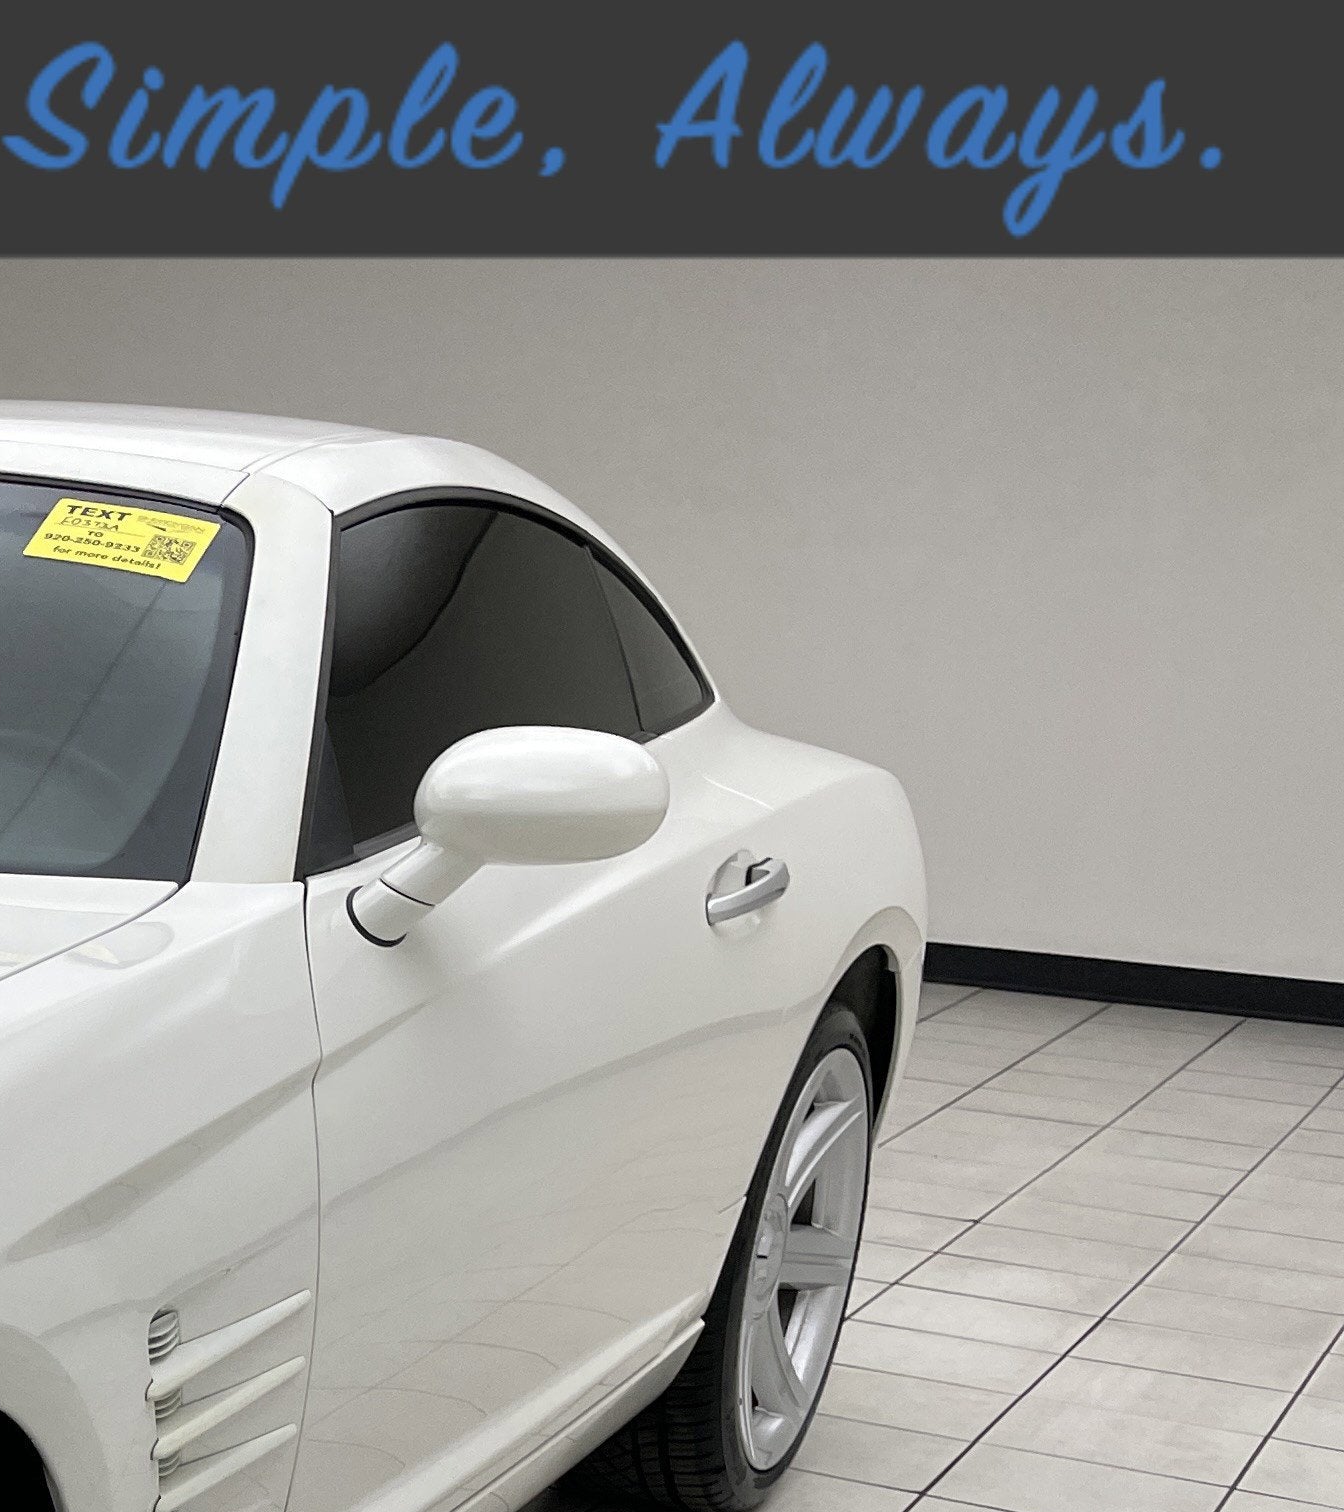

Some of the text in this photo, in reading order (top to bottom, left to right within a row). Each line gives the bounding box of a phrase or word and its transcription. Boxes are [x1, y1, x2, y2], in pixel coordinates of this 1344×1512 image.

[66, 504, 133, 521] TEXT
[88, 526, 104, 537] TO
[53, 545, 161, 569] for more details!
